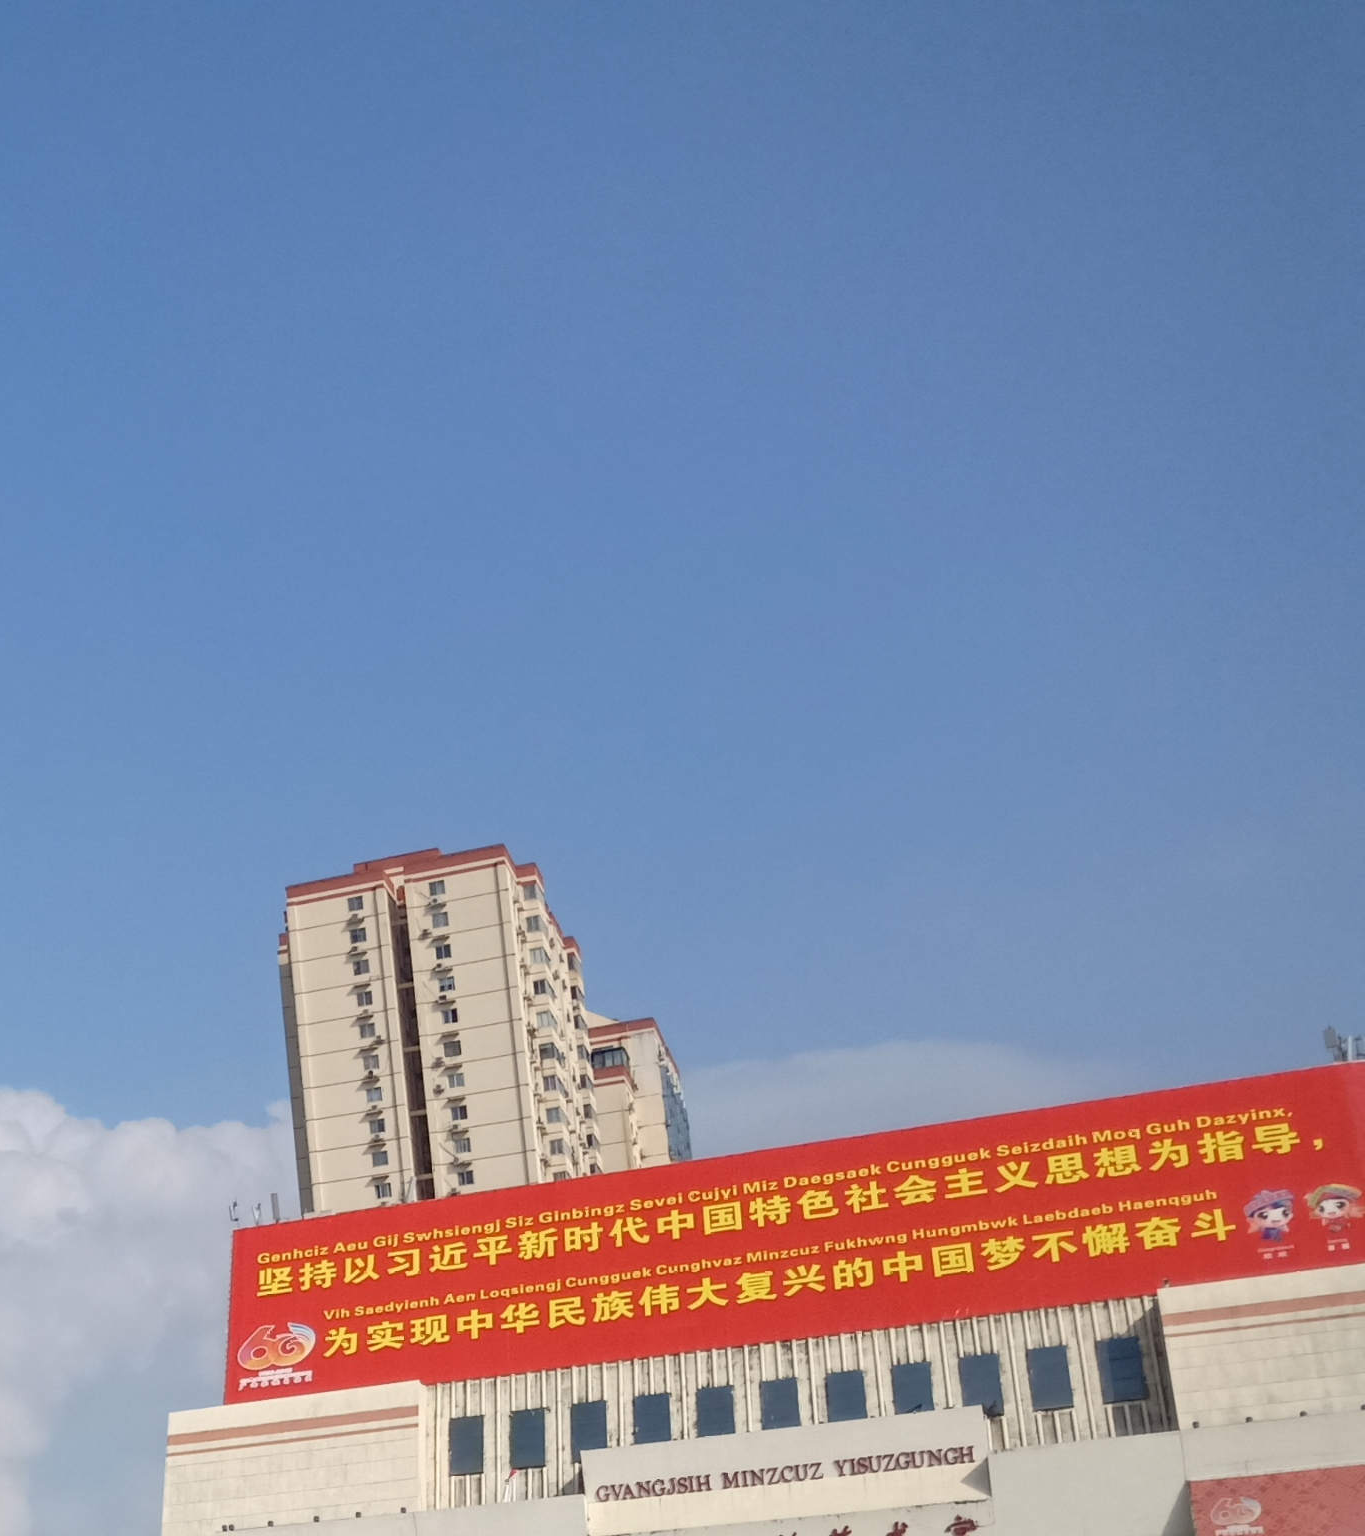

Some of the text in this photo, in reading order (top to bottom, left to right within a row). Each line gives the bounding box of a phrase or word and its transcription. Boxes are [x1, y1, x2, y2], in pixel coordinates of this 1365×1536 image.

[256, 1122, 1325, 1297] 坚持以习近平新时代中国特色社会主义思想为指导，
[257, 1245, 328, 1264] Genhciz
[373, 1234, 401, 1247] Gij
[403, 1220, 500, 1243] Swhsiengj
[506, 1216, 533, 1228] Siz
[539, 1204, 624, 1223] Ginbingz
[743, 1181, 779, 1195] Miz
[784, 1164, 881, 1189] Daegsaek
[887, 1148, 991, 1173] Cungguek
[997, 1134, 1087, 1158] Seizdaih
[1092, 1129, 1141, 1144] Moq
[1146, 1120, 1190, 1136] Guh
[324, 1308, 350, 1320] Vih
[355, 1297, 439, 1316] Saedyienh
[444, 1293, 475, 1304] Aen
[480, 1279, 561, 1299] Loqsiengj
[566, 1267, 651, 1287] Cungguek
[656, 1257, 741, 1275] Cunghvaz
[747, 1246, 819, 1263] Minzcuz
[825, 1234, 907, 1252] Fukhwng
[1023, 1204, 1113, 1224] Laebdaeb
[1119, 1190, 1217, 1211] Haenqguh
[323, 1208, 1237, 1358] 为实现中华民族伟大复兴的中国梦不懈奋斗
[596, 1446, 975, 1502] GVANGJSIH MINZCUZ YISUZGUNGH
